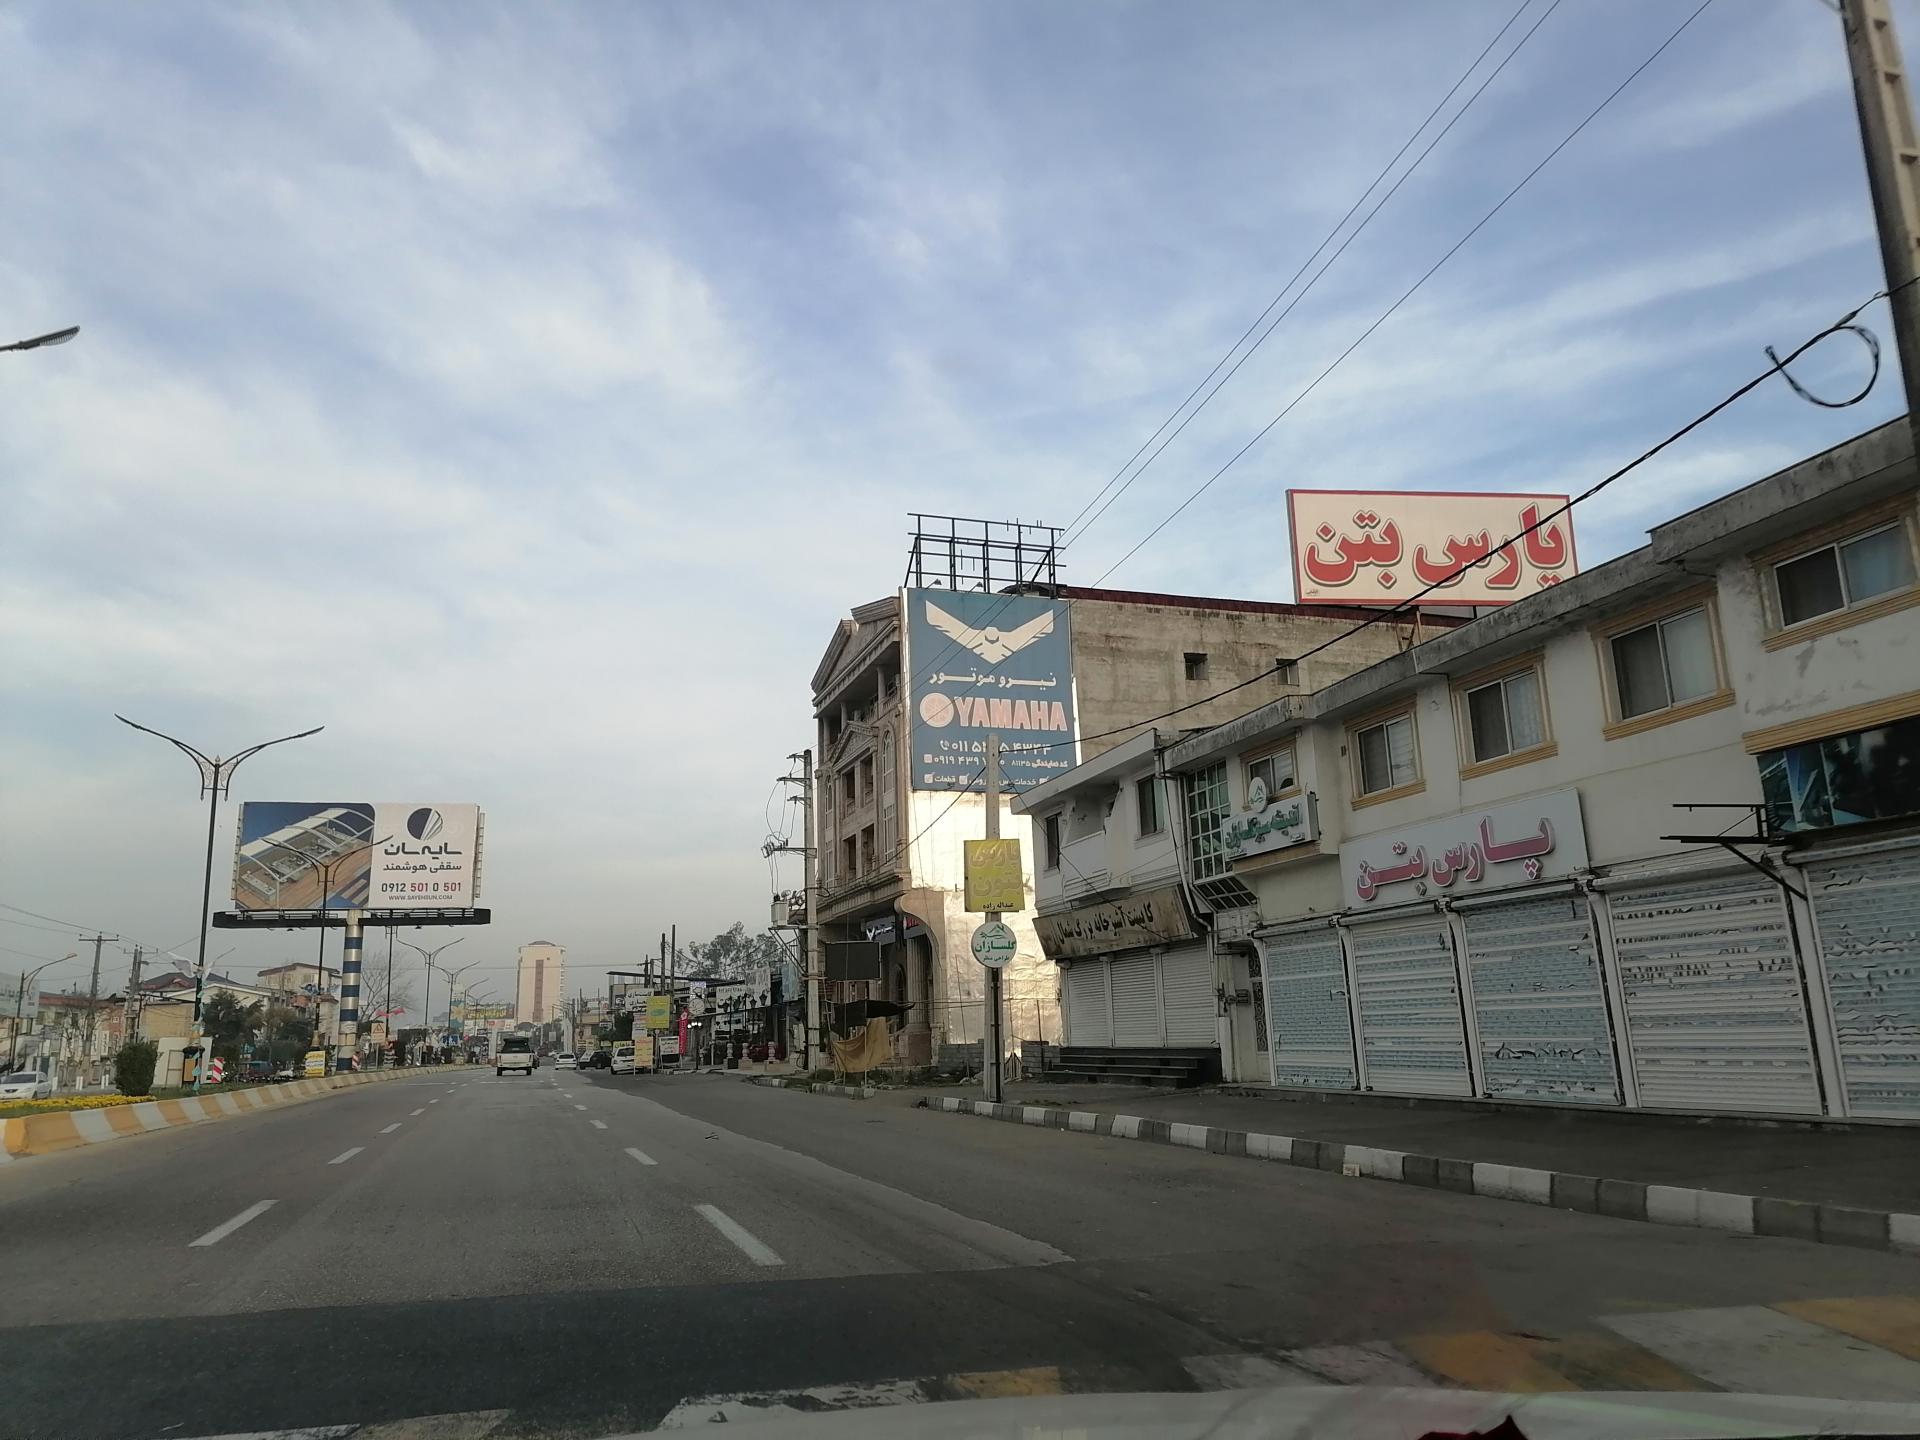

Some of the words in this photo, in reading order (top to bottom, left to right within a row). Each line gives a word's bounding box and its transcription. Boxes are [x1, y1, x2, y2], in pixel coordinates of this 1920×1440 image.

[1304, 509, 1404, 590] بتن
[1412, 502, 1568, 590] پارس
[929, 667, 996, 687] موتور
[998, 672, 1057, 691] نیرو
[953, 696, 1068, 732] YAMAHA
[1431, 815, 1555, 887] پارس
[383, 861, 428, 874] هوشمند
[429, 861, 462, 874] سقفی
[1356, 840, 1428, 901] بتن
[381, 882, 407, 893] 0912
[410, 882, 428, 892] 501
[432, 882, 439, 892] 0
[443, 882, 462, 892] 501
[974, 940, 1017, 953] گلسازان
